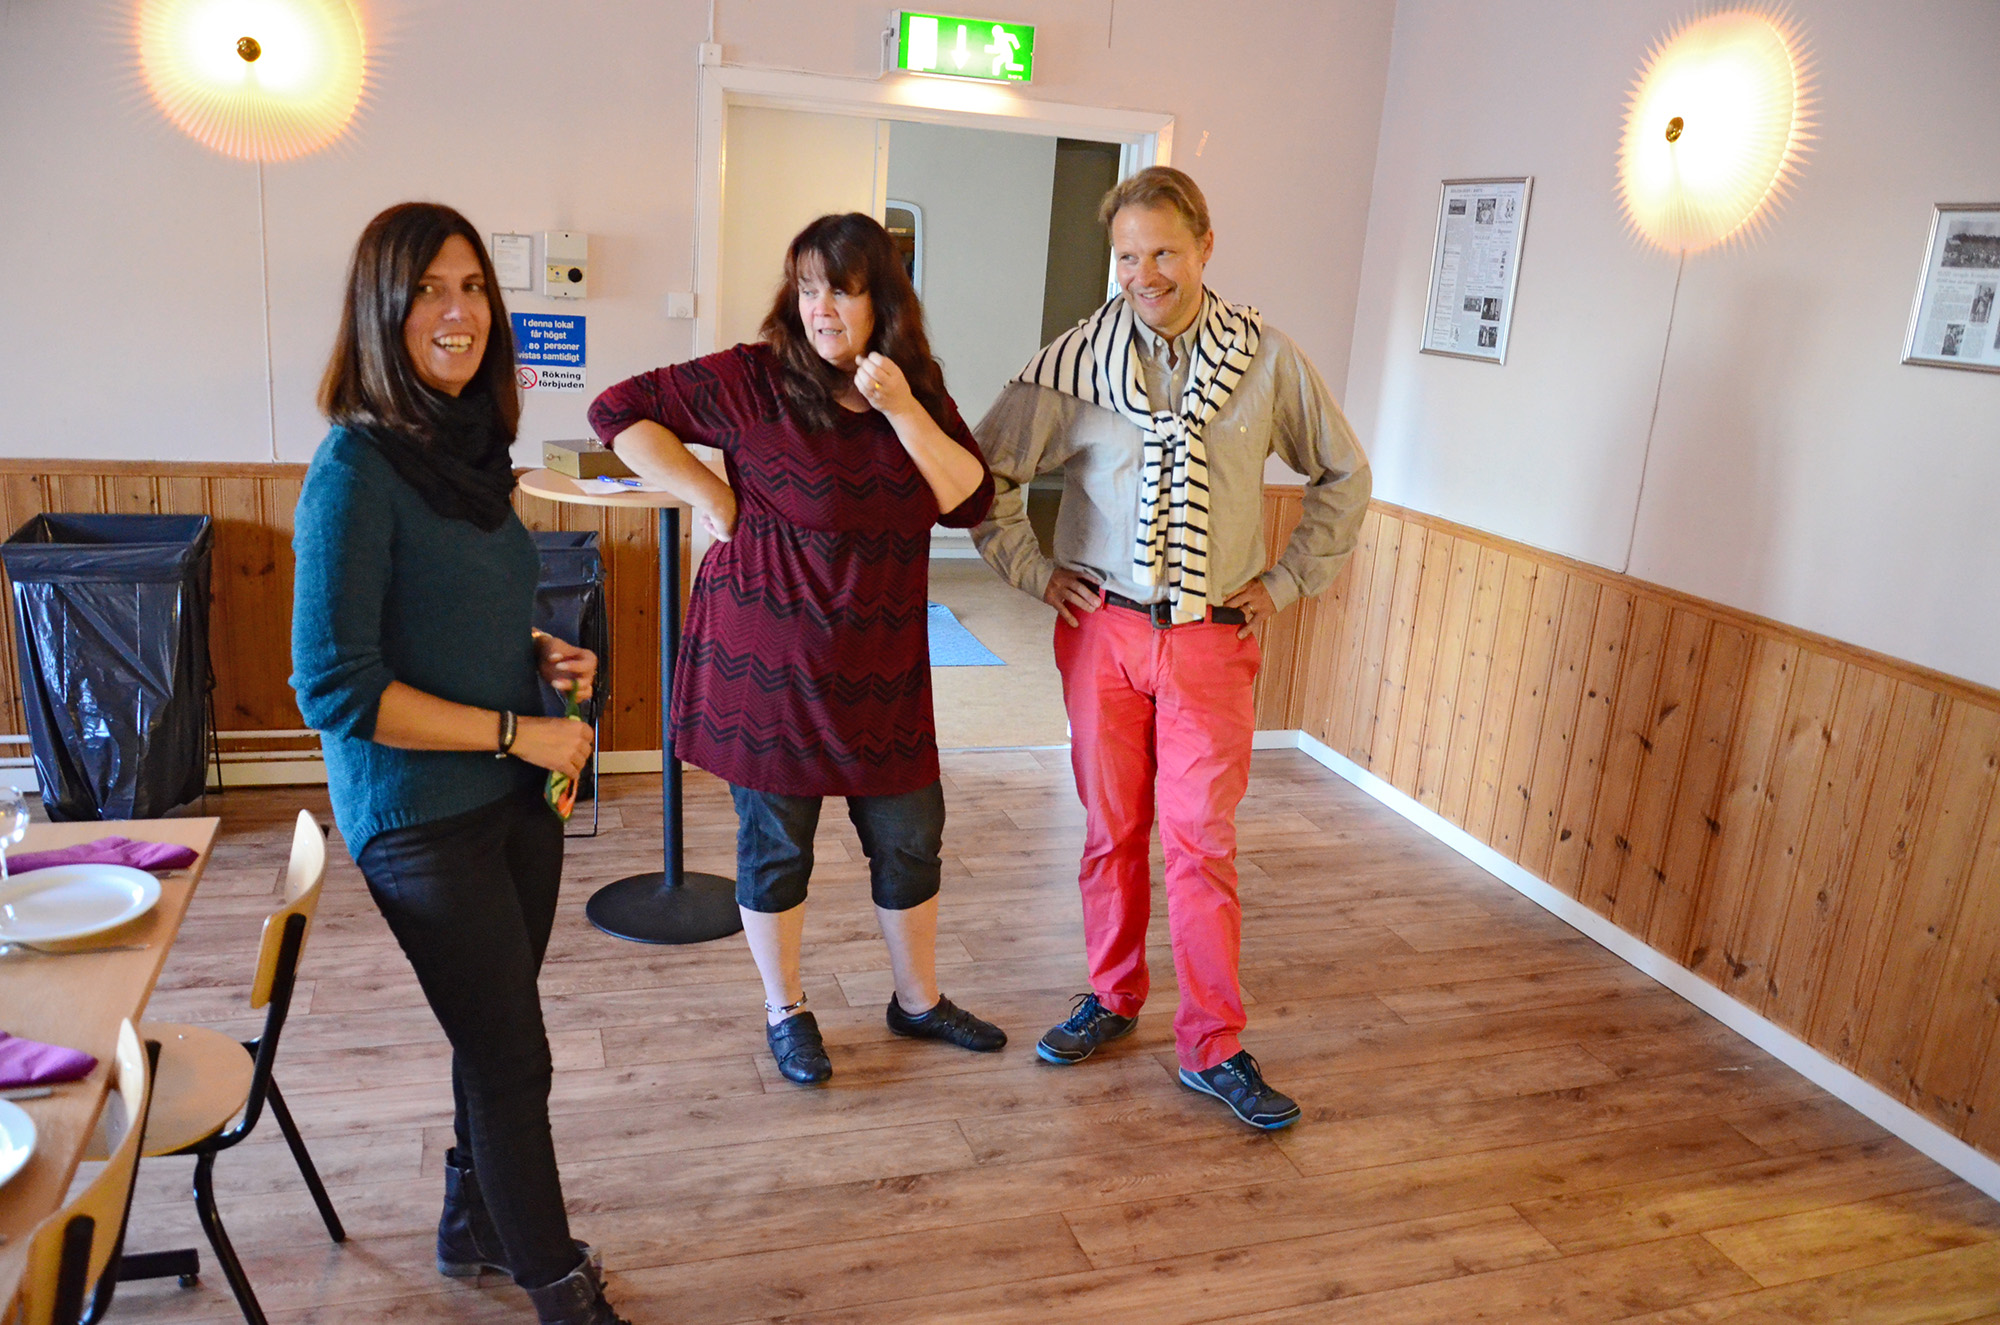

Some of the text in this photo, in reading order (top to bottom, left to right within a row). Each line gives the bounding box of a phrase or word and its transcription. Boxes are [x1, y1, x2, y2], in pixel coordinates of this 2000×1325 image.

[528, 319, 552, 328] denna
[554, 320, 574, 329] lokal
[530, 330, 566, 340] får högst
[528, 342, 540, 350] 80
[518, 351, 579, 362] vistas samtidigt
[542, 370, 581, 380] Rökning
[539, 380, 585, 389] förbjuden
